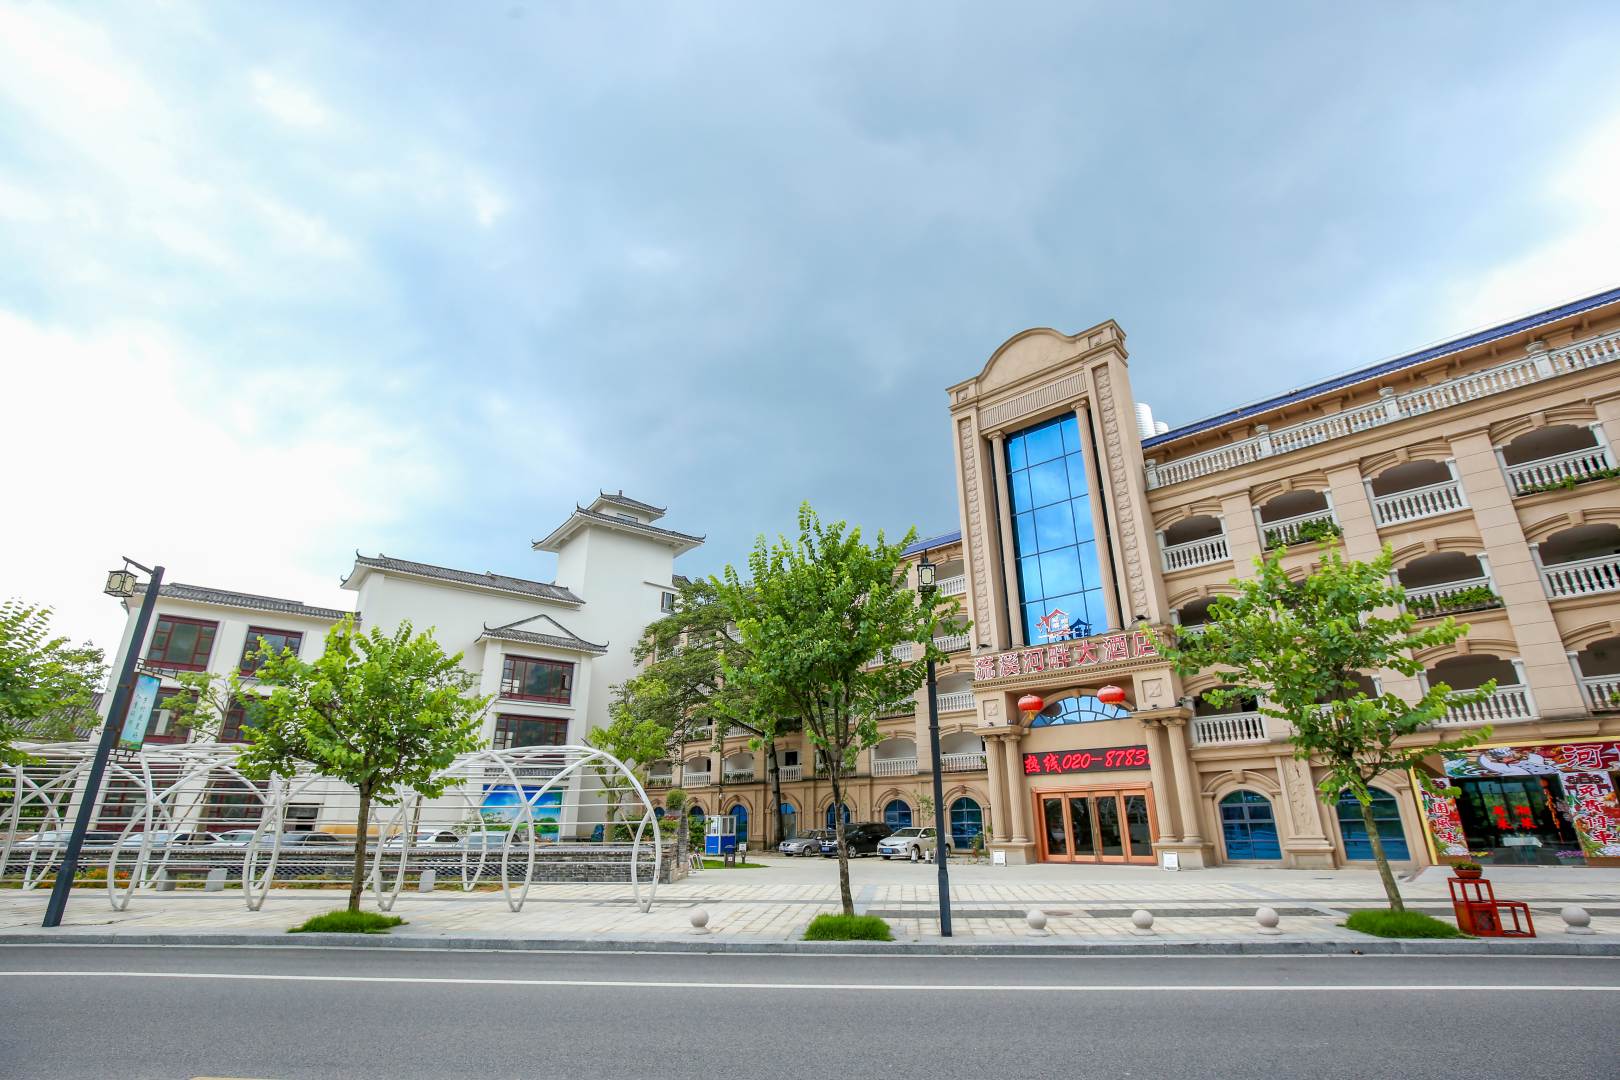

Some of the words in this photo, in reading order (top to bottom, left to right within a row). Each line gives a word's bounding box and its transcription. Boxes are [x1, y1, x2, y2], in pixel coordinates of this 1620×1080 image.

[974, 629, 1159, 680] 流溪河畔大酒店
